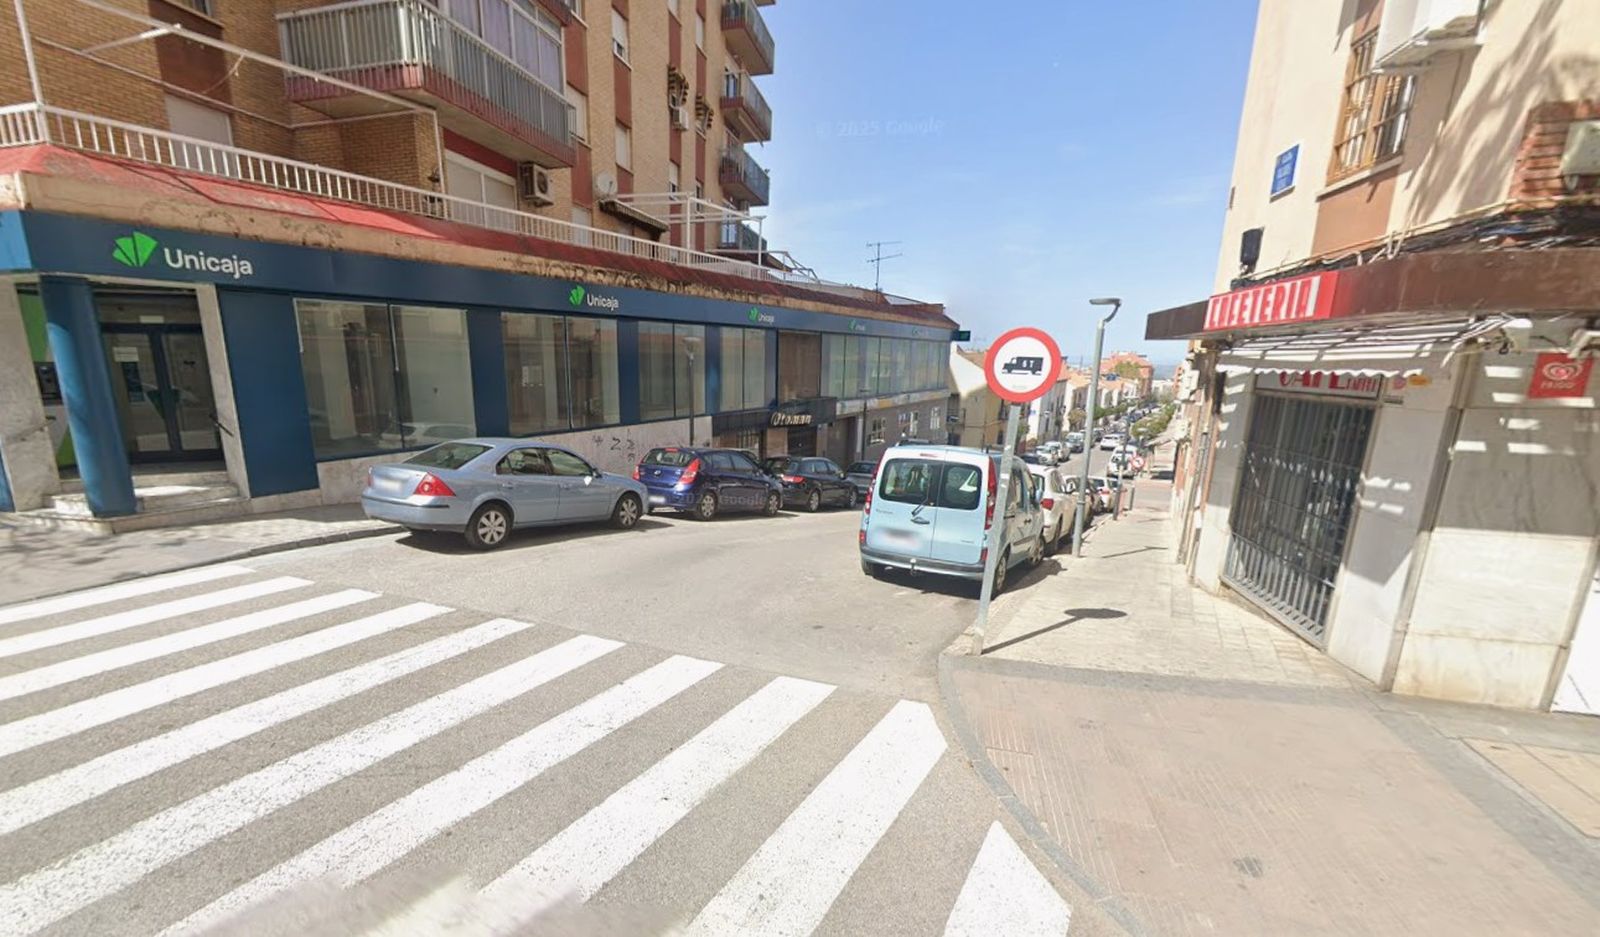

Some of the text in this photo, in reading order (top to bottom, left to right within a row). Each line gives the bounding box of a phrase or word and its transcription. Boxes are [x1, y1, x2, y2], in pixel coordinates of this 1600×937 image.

[163, 247, 253, 279] Unicaja
[586, 293, 620, 311] Unicaja
[1205, 277, 1317, 329] CAFETERIA
